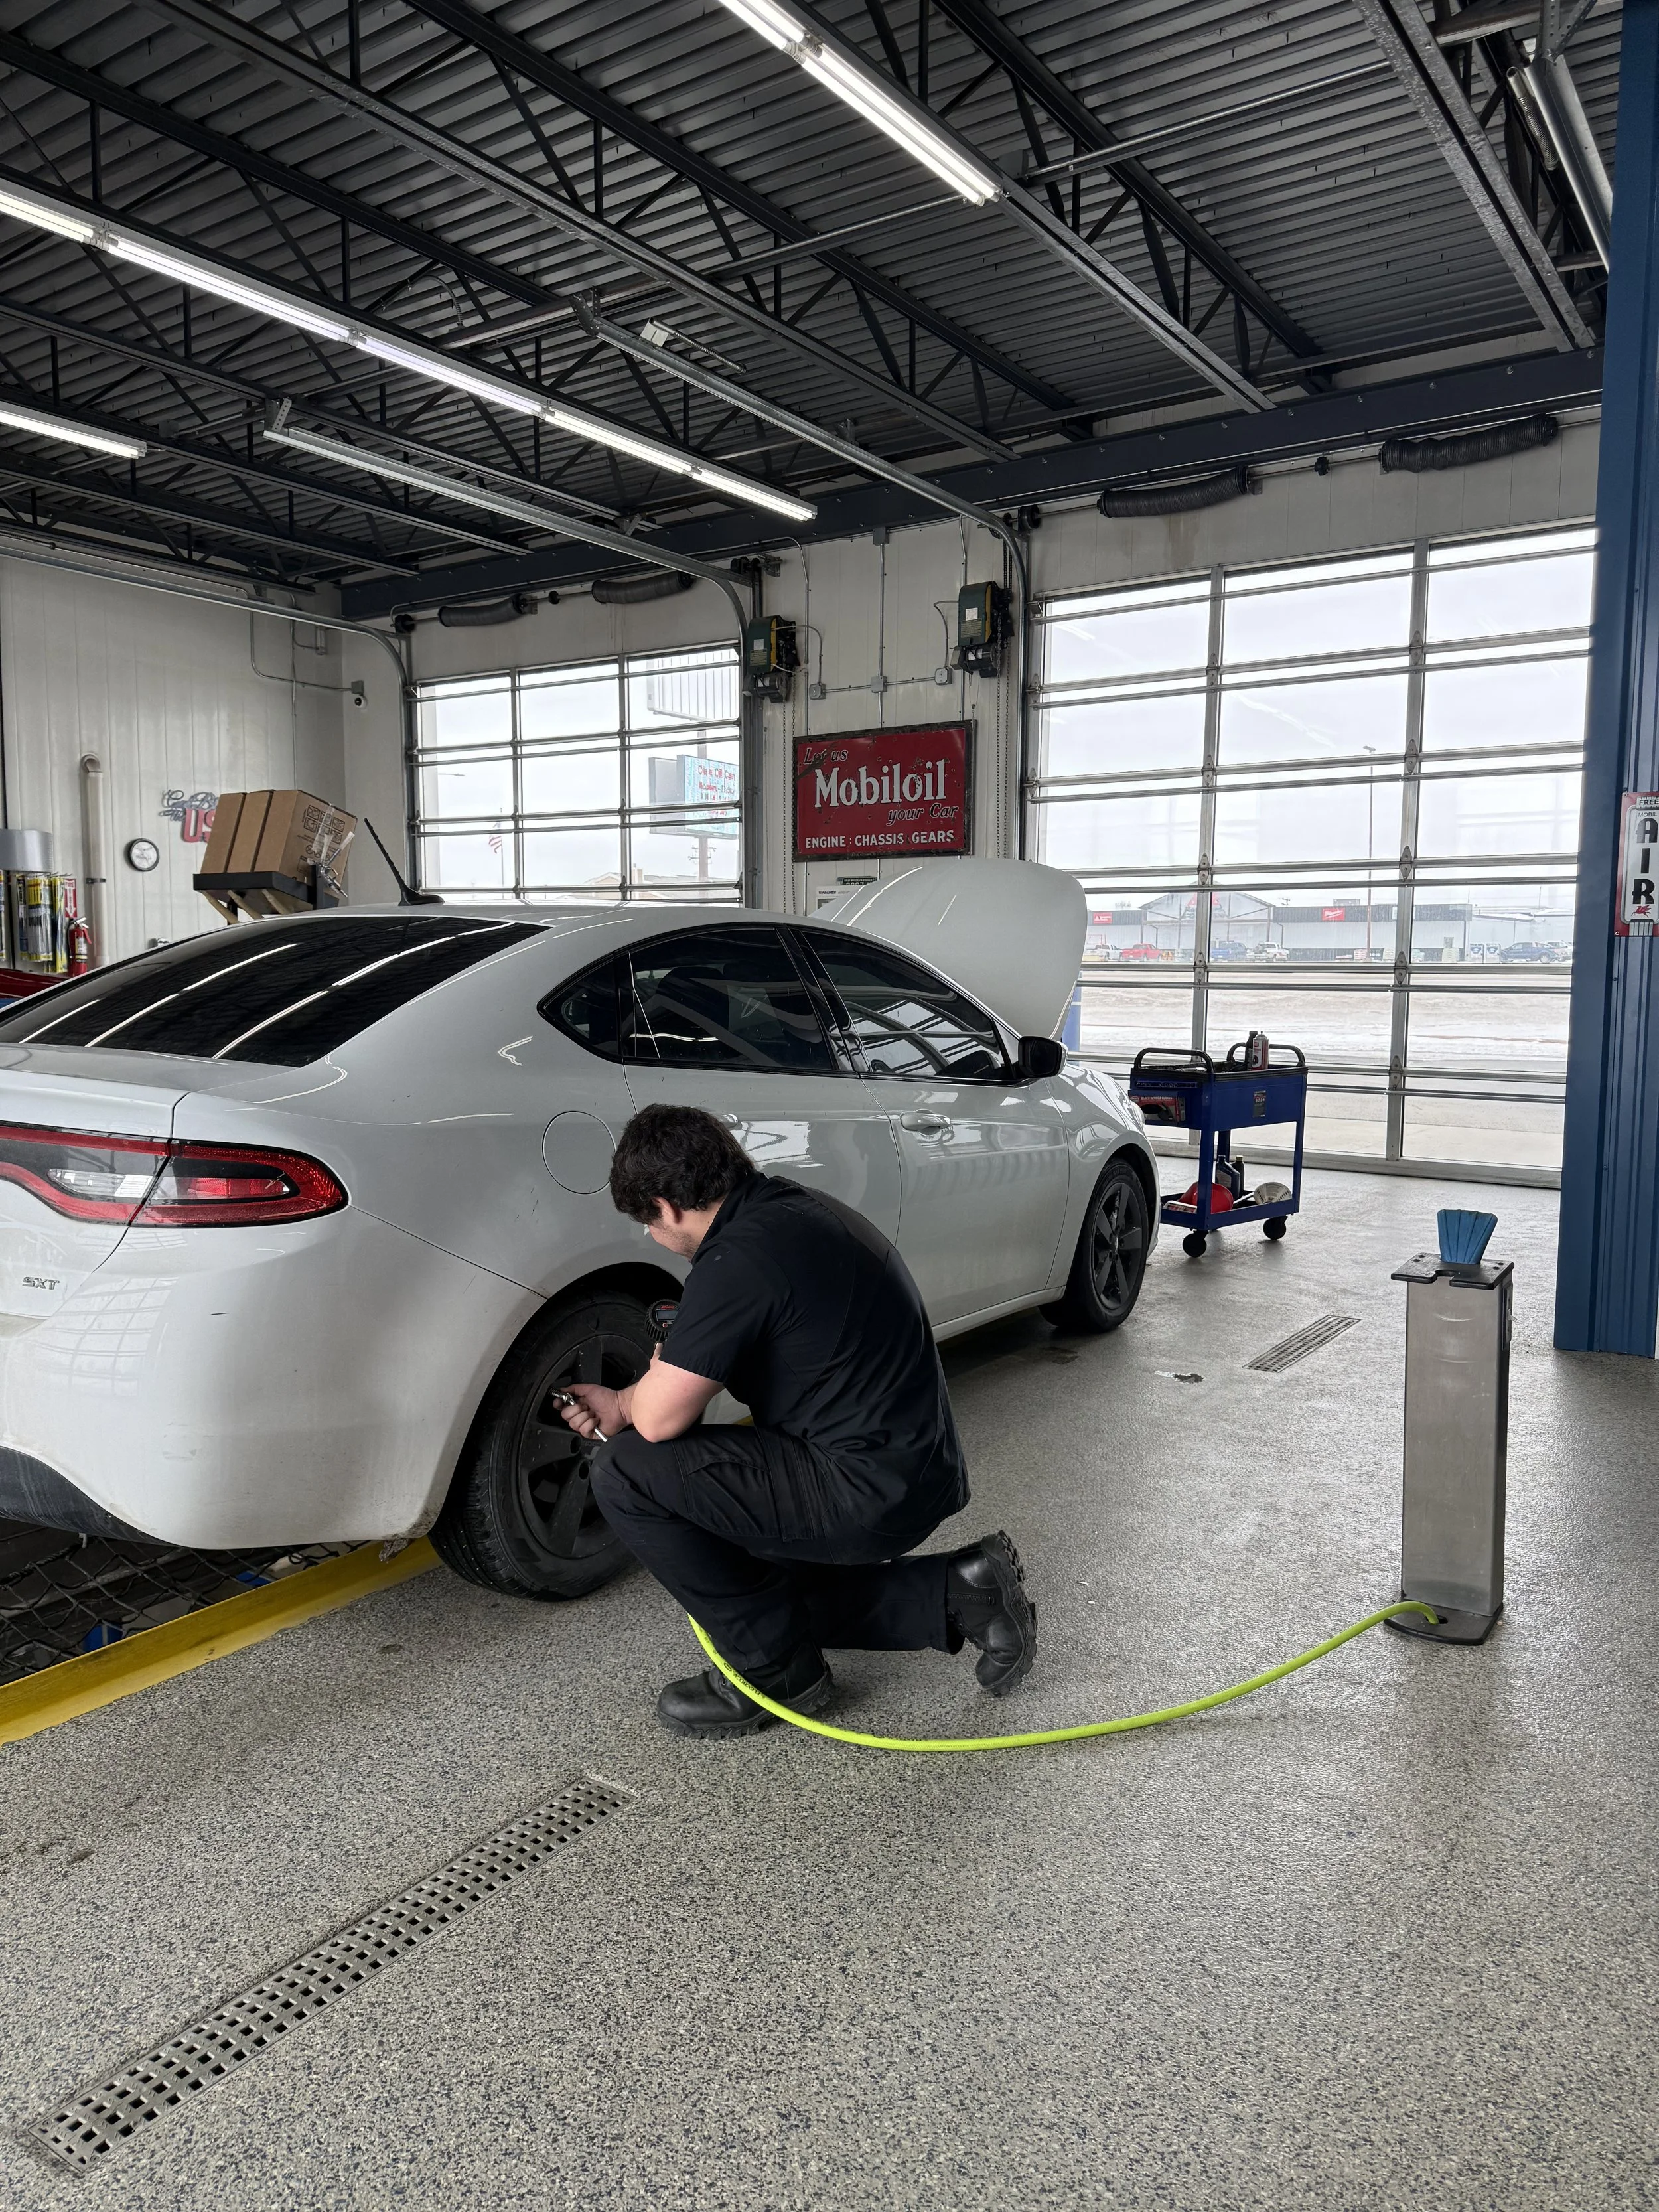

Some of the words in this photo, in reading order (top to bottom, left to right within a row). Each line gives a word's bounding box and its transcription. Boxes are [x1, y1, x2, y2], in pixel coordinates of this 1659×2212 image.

[831, 749, 848, 762] us
[814, 759, 947, 808] Mobiloil
[886, 808, 924, 826] your
[930, 803, 959, 818] Car
[806, 836, 846, 849] ENGINE
[855, 833, 904, 847] CHASSIS
[912, 830, 954, 844] GEARS
[1632, 817, 1658, 905] AIR
[22, 1276, 60, 1290] SXT
